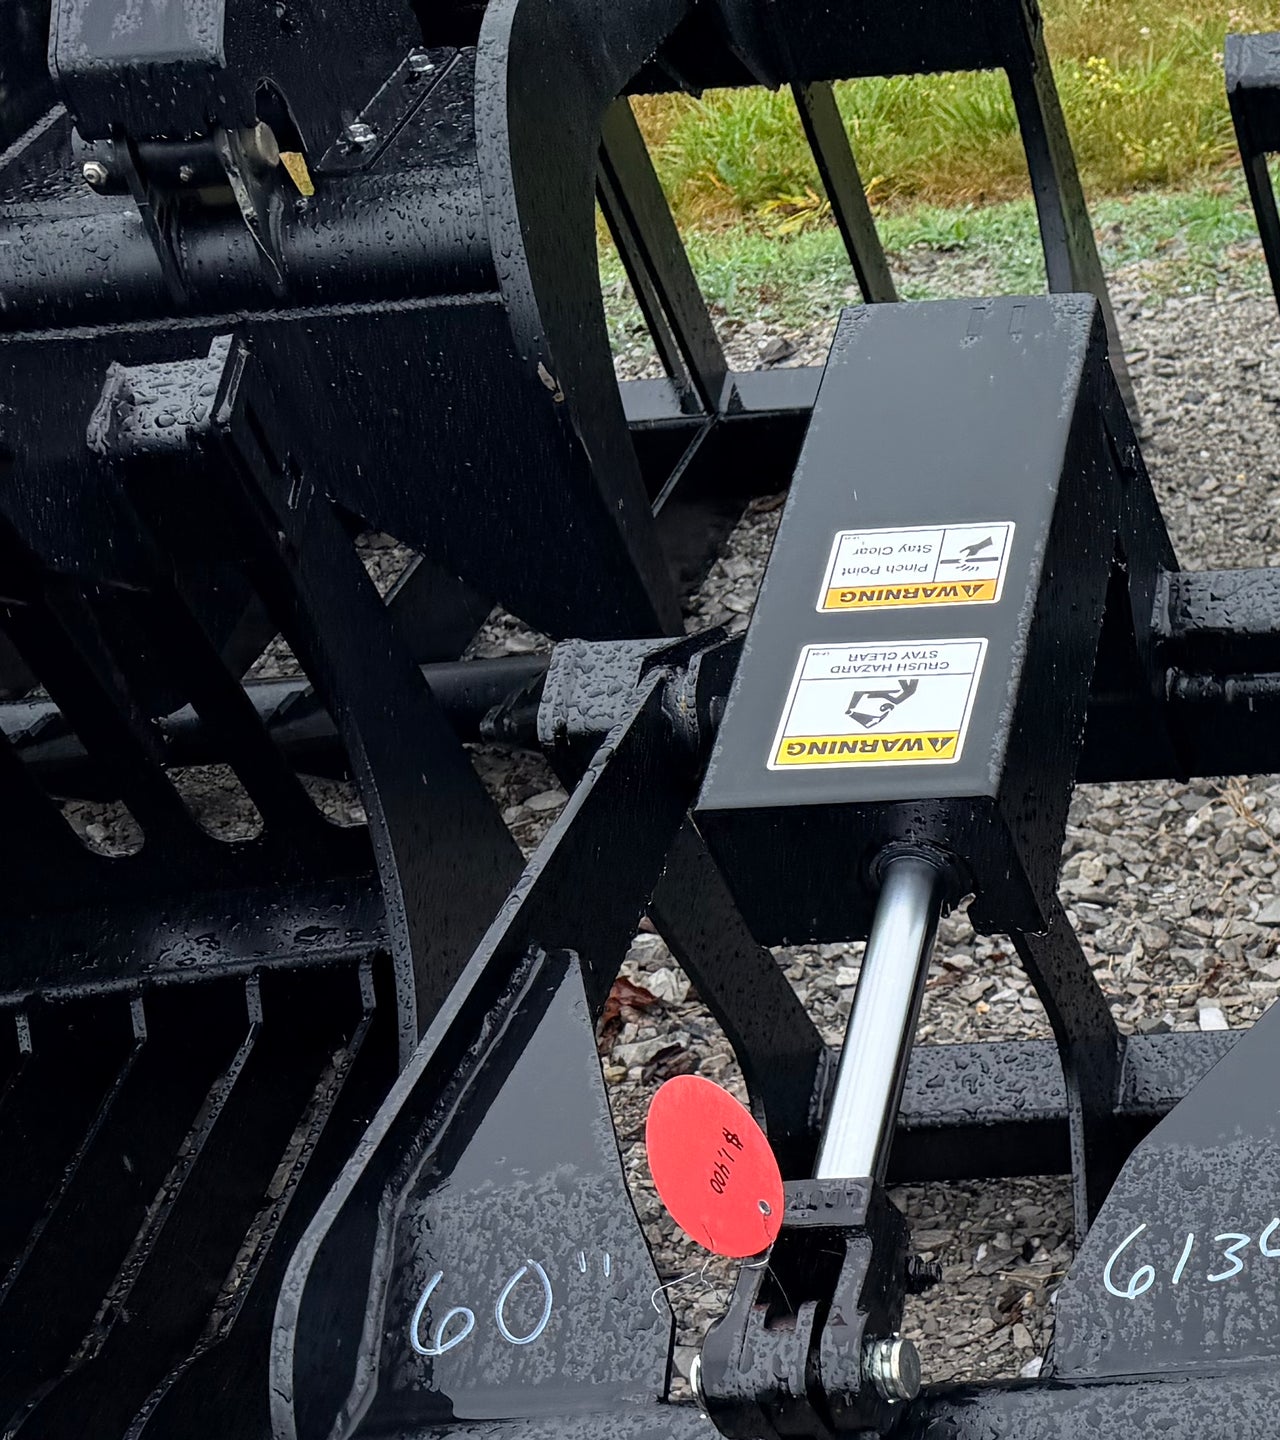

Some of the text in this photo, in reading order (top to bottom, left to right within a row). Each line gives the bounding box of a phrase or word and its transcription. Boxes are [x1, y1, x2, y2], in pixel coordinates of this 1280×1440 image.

[852, 543, 933, 556] Stay Clear
[841, 563, 928, 577] Pinch Point
[839, 585, 959, 603] WARNING
[848, 650, 939, 662] STAY CLEAR
[830, 661, 950, 674] CRUSH HAZARD
[786, 737, 925, 757] WARNING
[410, 1250, 612, 1356] 60"
